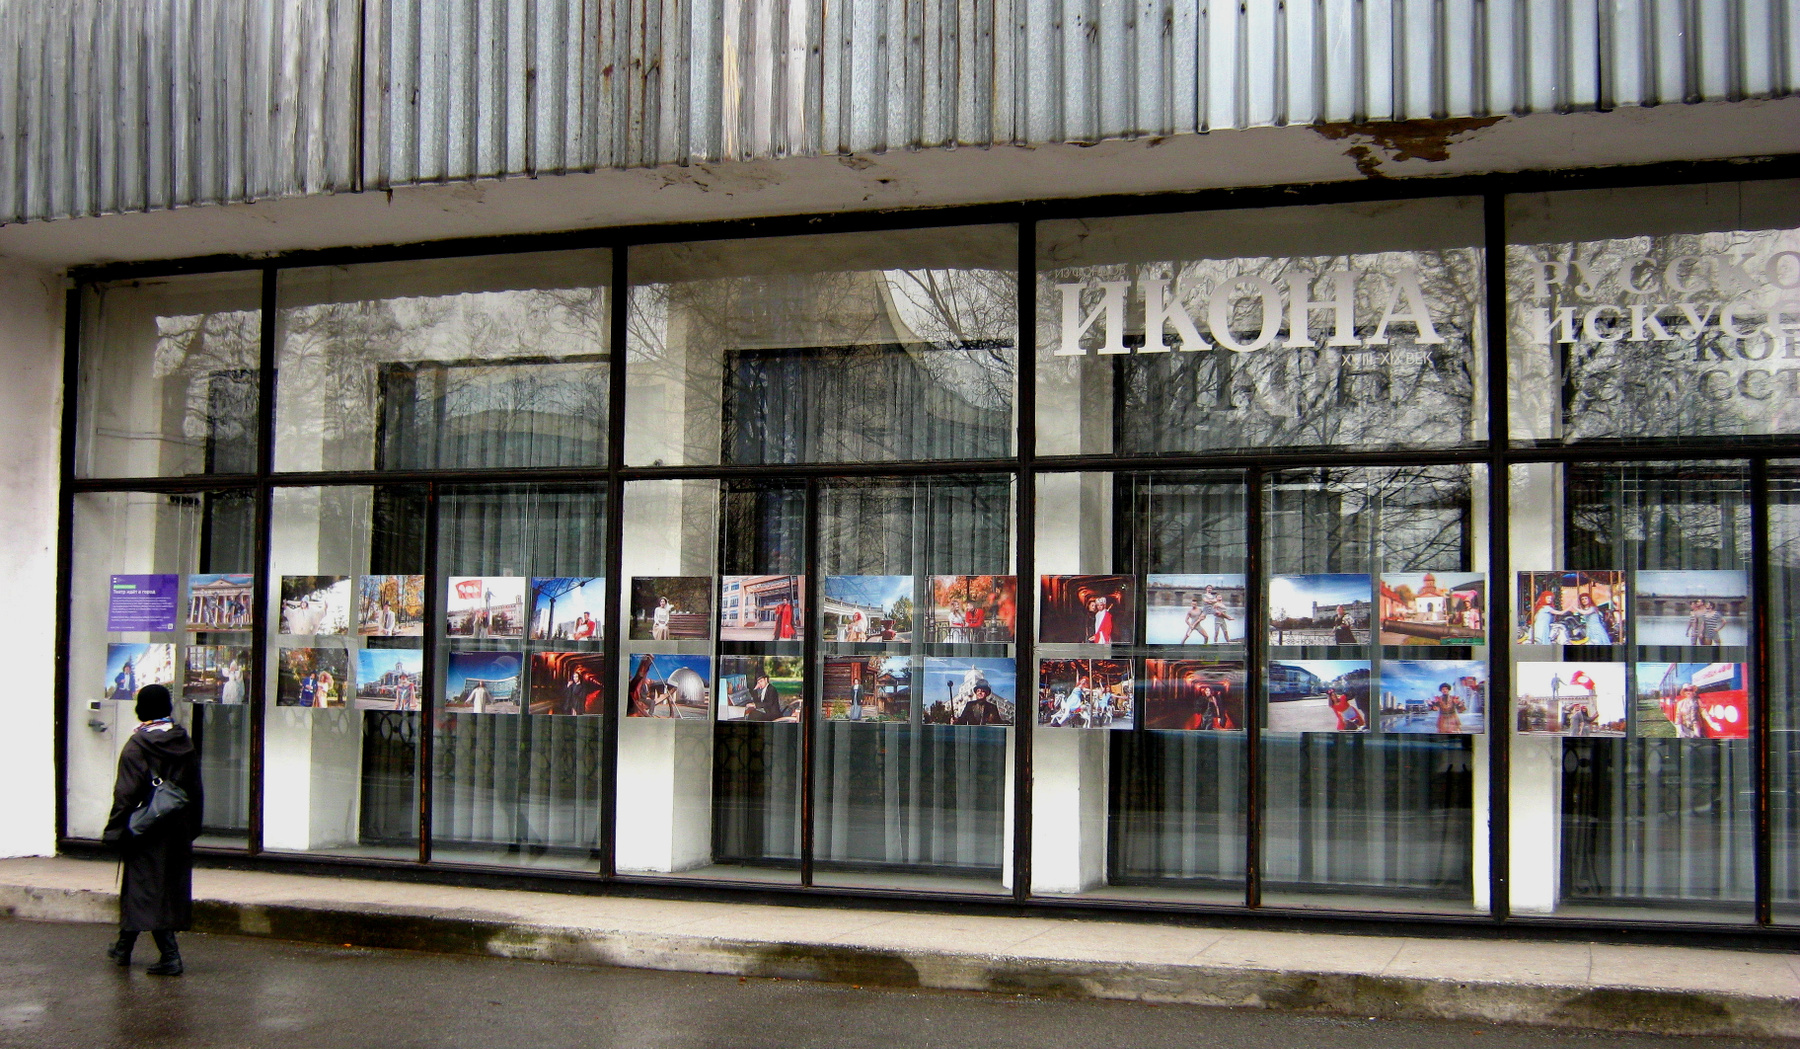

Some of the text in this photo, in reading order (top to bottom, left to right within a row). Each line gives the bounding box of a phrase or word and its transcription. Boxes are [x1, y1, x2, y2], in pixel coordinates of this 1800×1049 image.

[1531, 250, 1800, 299] РУССКО
[1054, 266, 1446, 356] ИКОНА
[1406, 351, 1433, 365] ВЕК
